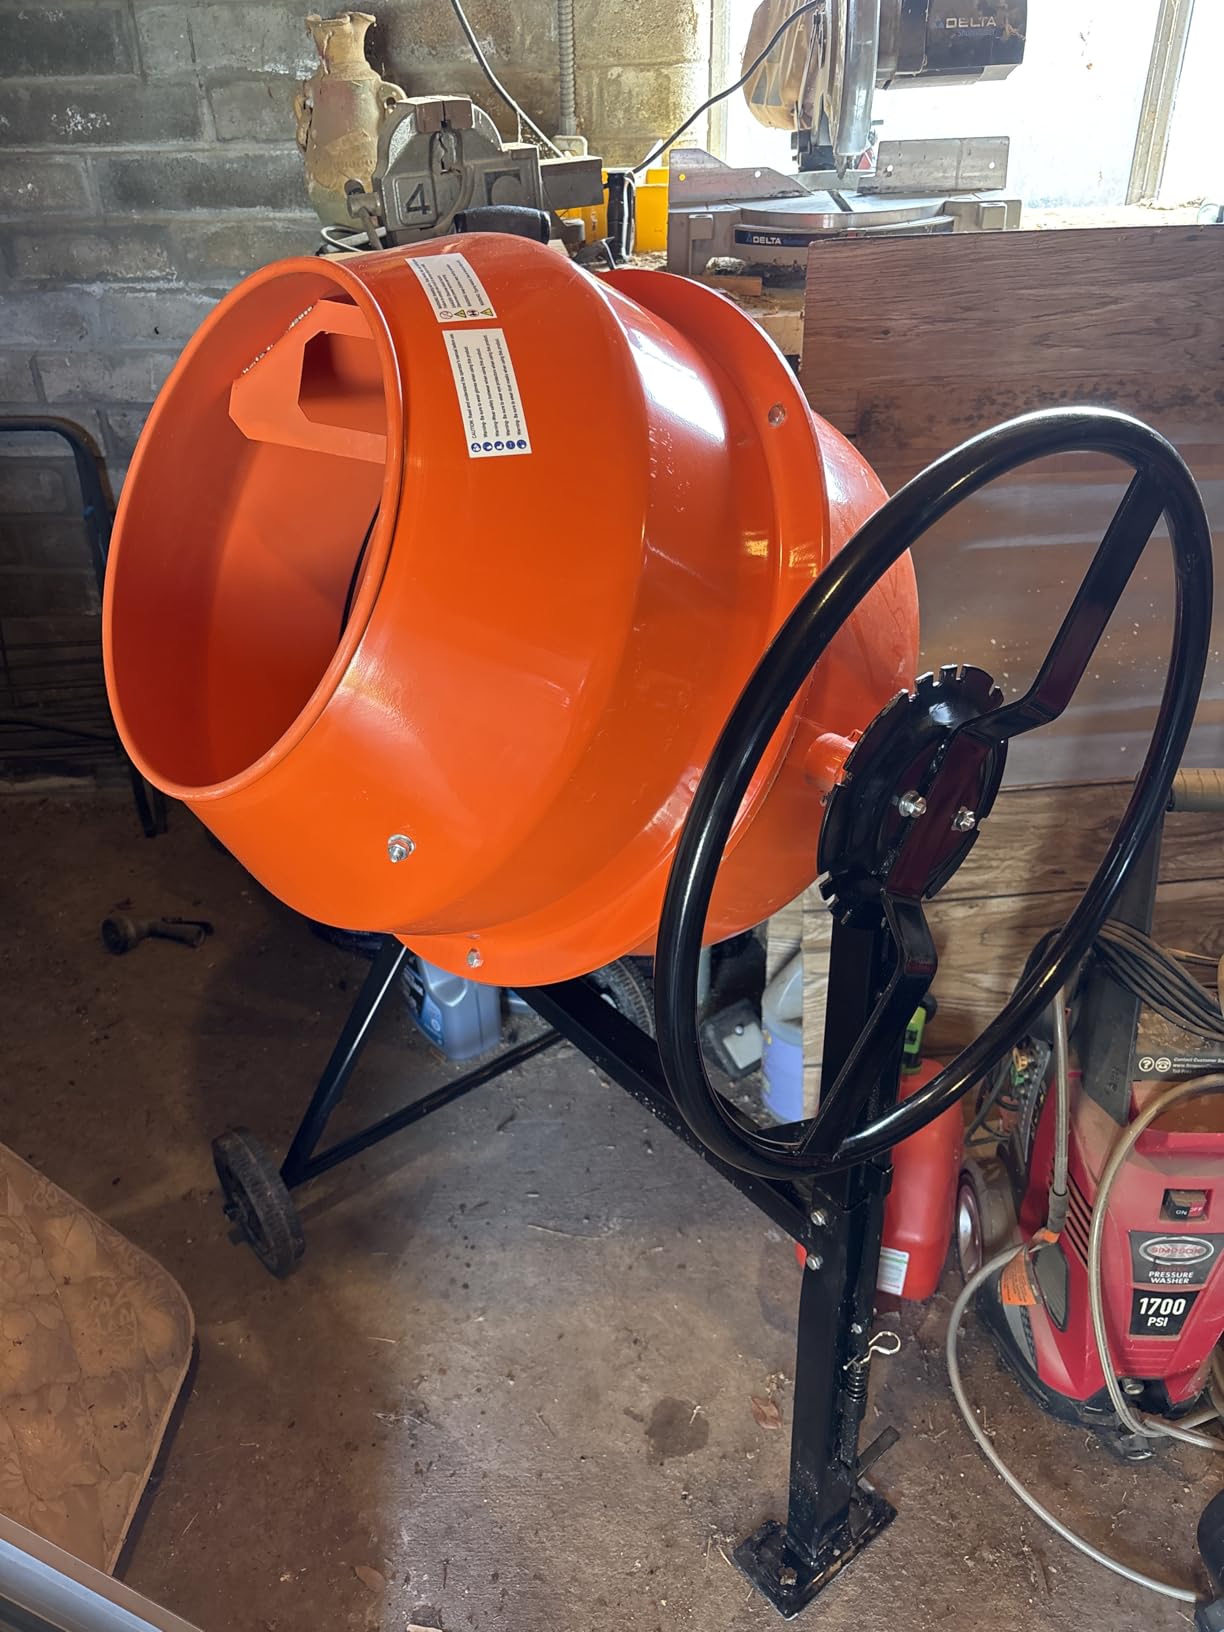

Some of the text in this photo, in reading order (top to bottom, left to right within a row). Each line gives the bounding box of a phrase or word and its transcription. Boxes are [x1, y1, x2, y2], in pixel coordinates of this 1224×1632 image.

[946, 16, 997, 28] DELTA
[406, 183, 430, 215] 4
[752, 236, 782, 244] DELTA
[1139, 1298, 1186, 1316] 1700
[1148, 1317, 1168, 1327] PSI
